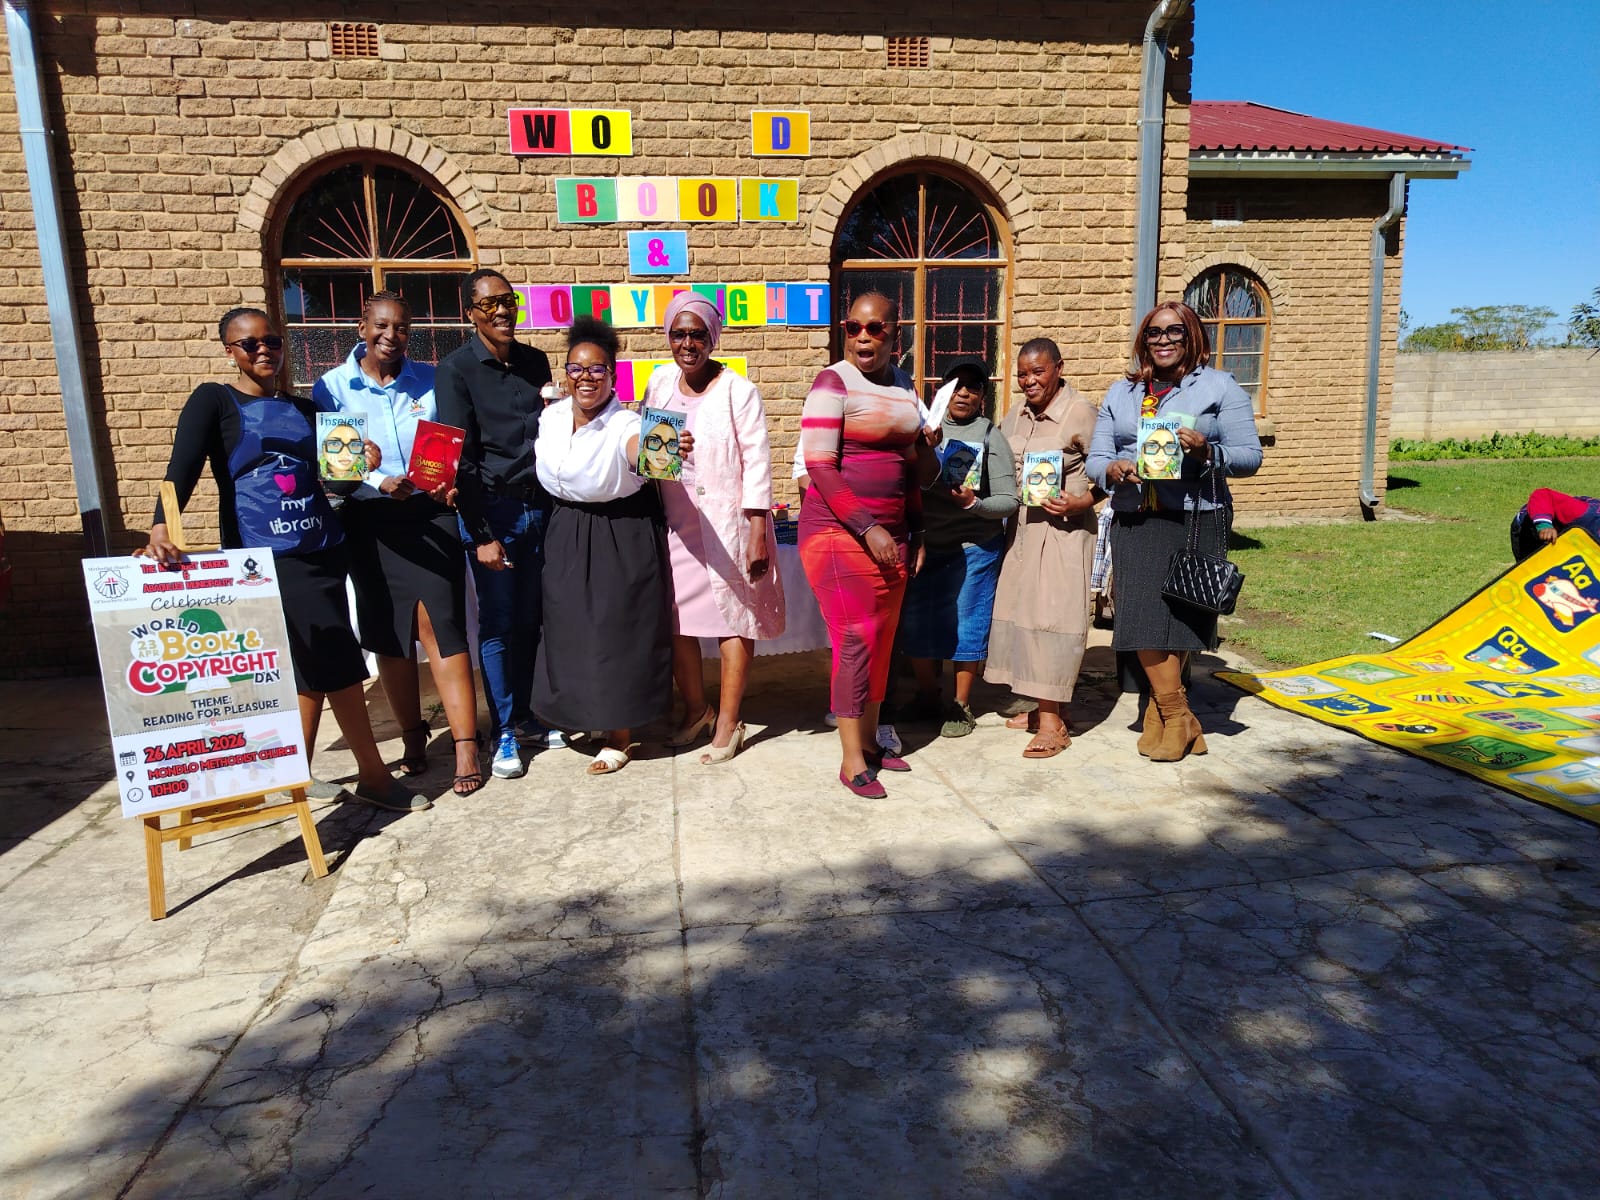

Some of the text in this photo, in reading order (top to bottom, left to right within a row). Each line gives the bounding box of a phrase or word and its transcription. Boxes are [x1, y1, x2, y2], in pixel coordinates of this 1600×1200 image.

[576, 183, 779, 217] BOOK
[647, 238, 669, 266] &
[281, 497, 306, 511] my
[269, 516, 322, 535] library
[200, 559, 229, 569] CHURCH
[185, 577, 234, 590] MUNICIPALITY
[1562, 562, 1592, 590] Aa
[151, 593, 237, 611] Celebrates
[132, 619, 199, 639] WORLD
[137, 640, 157, 650] 23
[245, 630, 261, 648] &
[138, 650, 160, 658] APR
[128, 651, 278, 693] COPYRIGHT
[254, 670, 281, 683] DAY
[191, 696, 232, 709] THEME:
[143, 699, 280, 727] READING FOR PLEASURE
[144, 732, 246, 764] 26 APRIL 2026
[148, 745, 298, 781] MONDLO METHODIST CHURCH
[148, 780, 188, 798] 10H00
